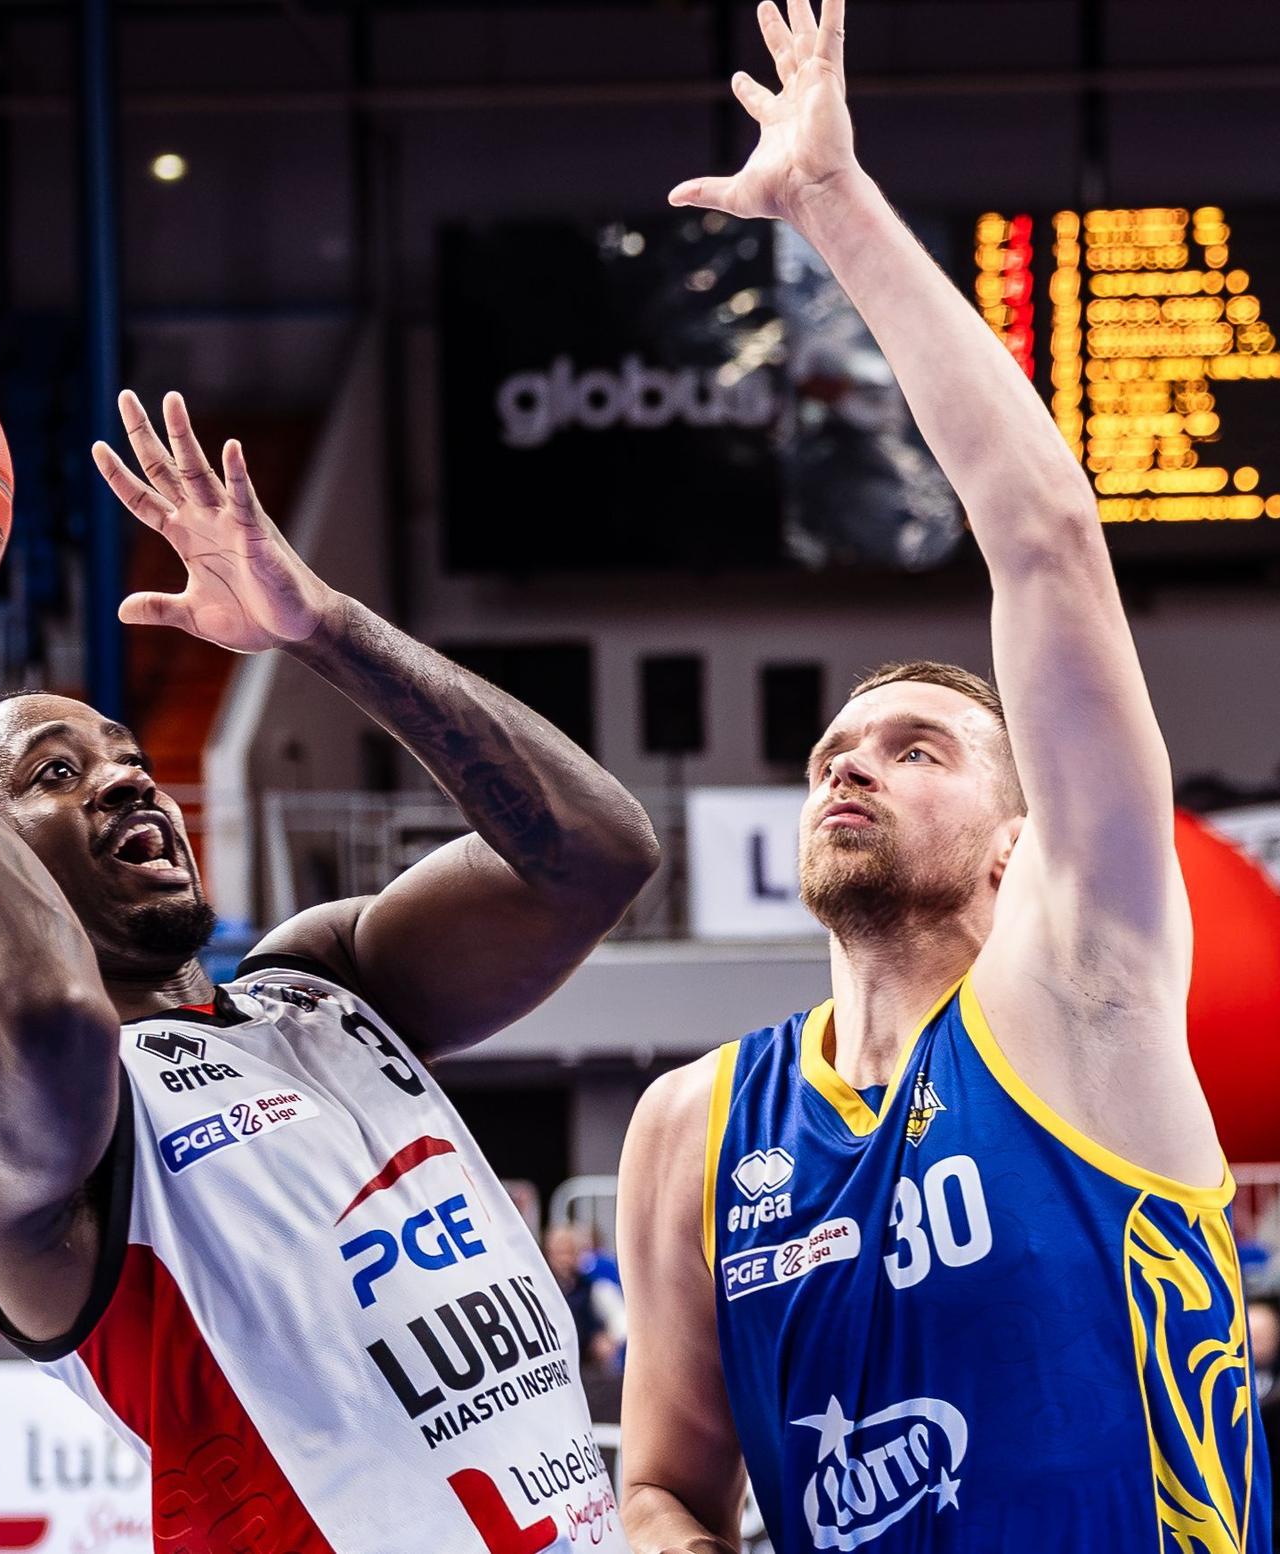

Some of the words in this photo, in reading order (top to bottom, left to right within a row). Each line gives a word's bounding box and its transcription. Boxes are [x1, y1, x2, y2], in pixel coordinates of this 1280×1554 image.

[340, 1011, 426, 1097] 3
[256, 1092, 302, 1111] Basket
[265, 1107, 297, 1124] Liga
[171, 1122, 227, 1162] PGE
[809, 1225, 849, 1250] asket
[883, 1154, 994, 1290] 30
[339, 1193, 487, 1310] PGE
[727, 1257, 768, 1290] PGE
[420, 1380, 520, 1450] MIASTO
[823, 1423, 929, 1527] LOTTO
